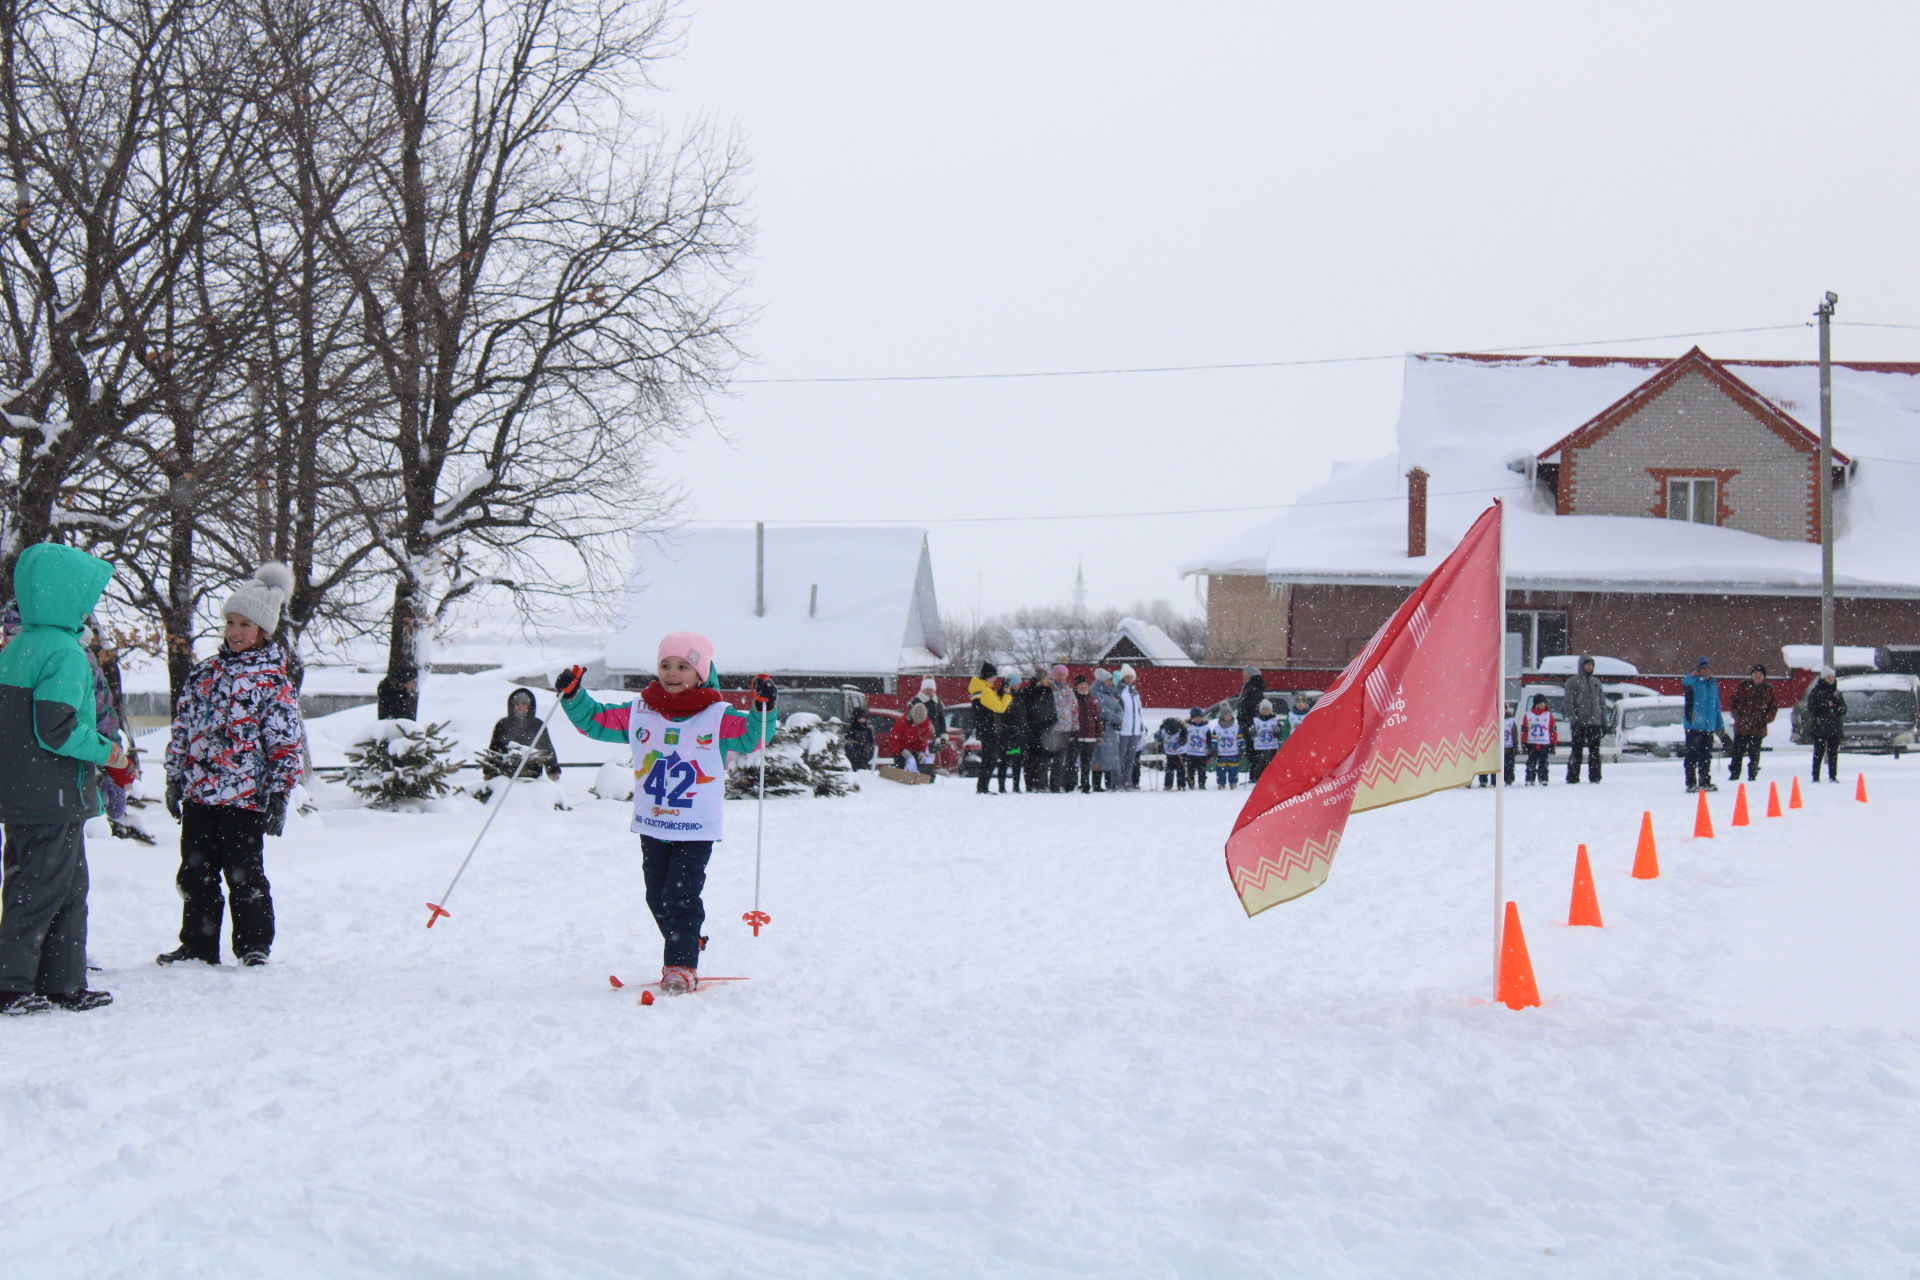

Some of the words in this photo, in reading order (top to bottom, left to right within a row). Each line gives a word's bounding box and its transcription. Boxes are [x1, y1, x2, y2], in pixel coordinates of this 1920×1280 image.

[1531, 723, 1544, 736] 21
[1220, 737, 1234, 748] 35
[643, 759, 696, 808] 42
